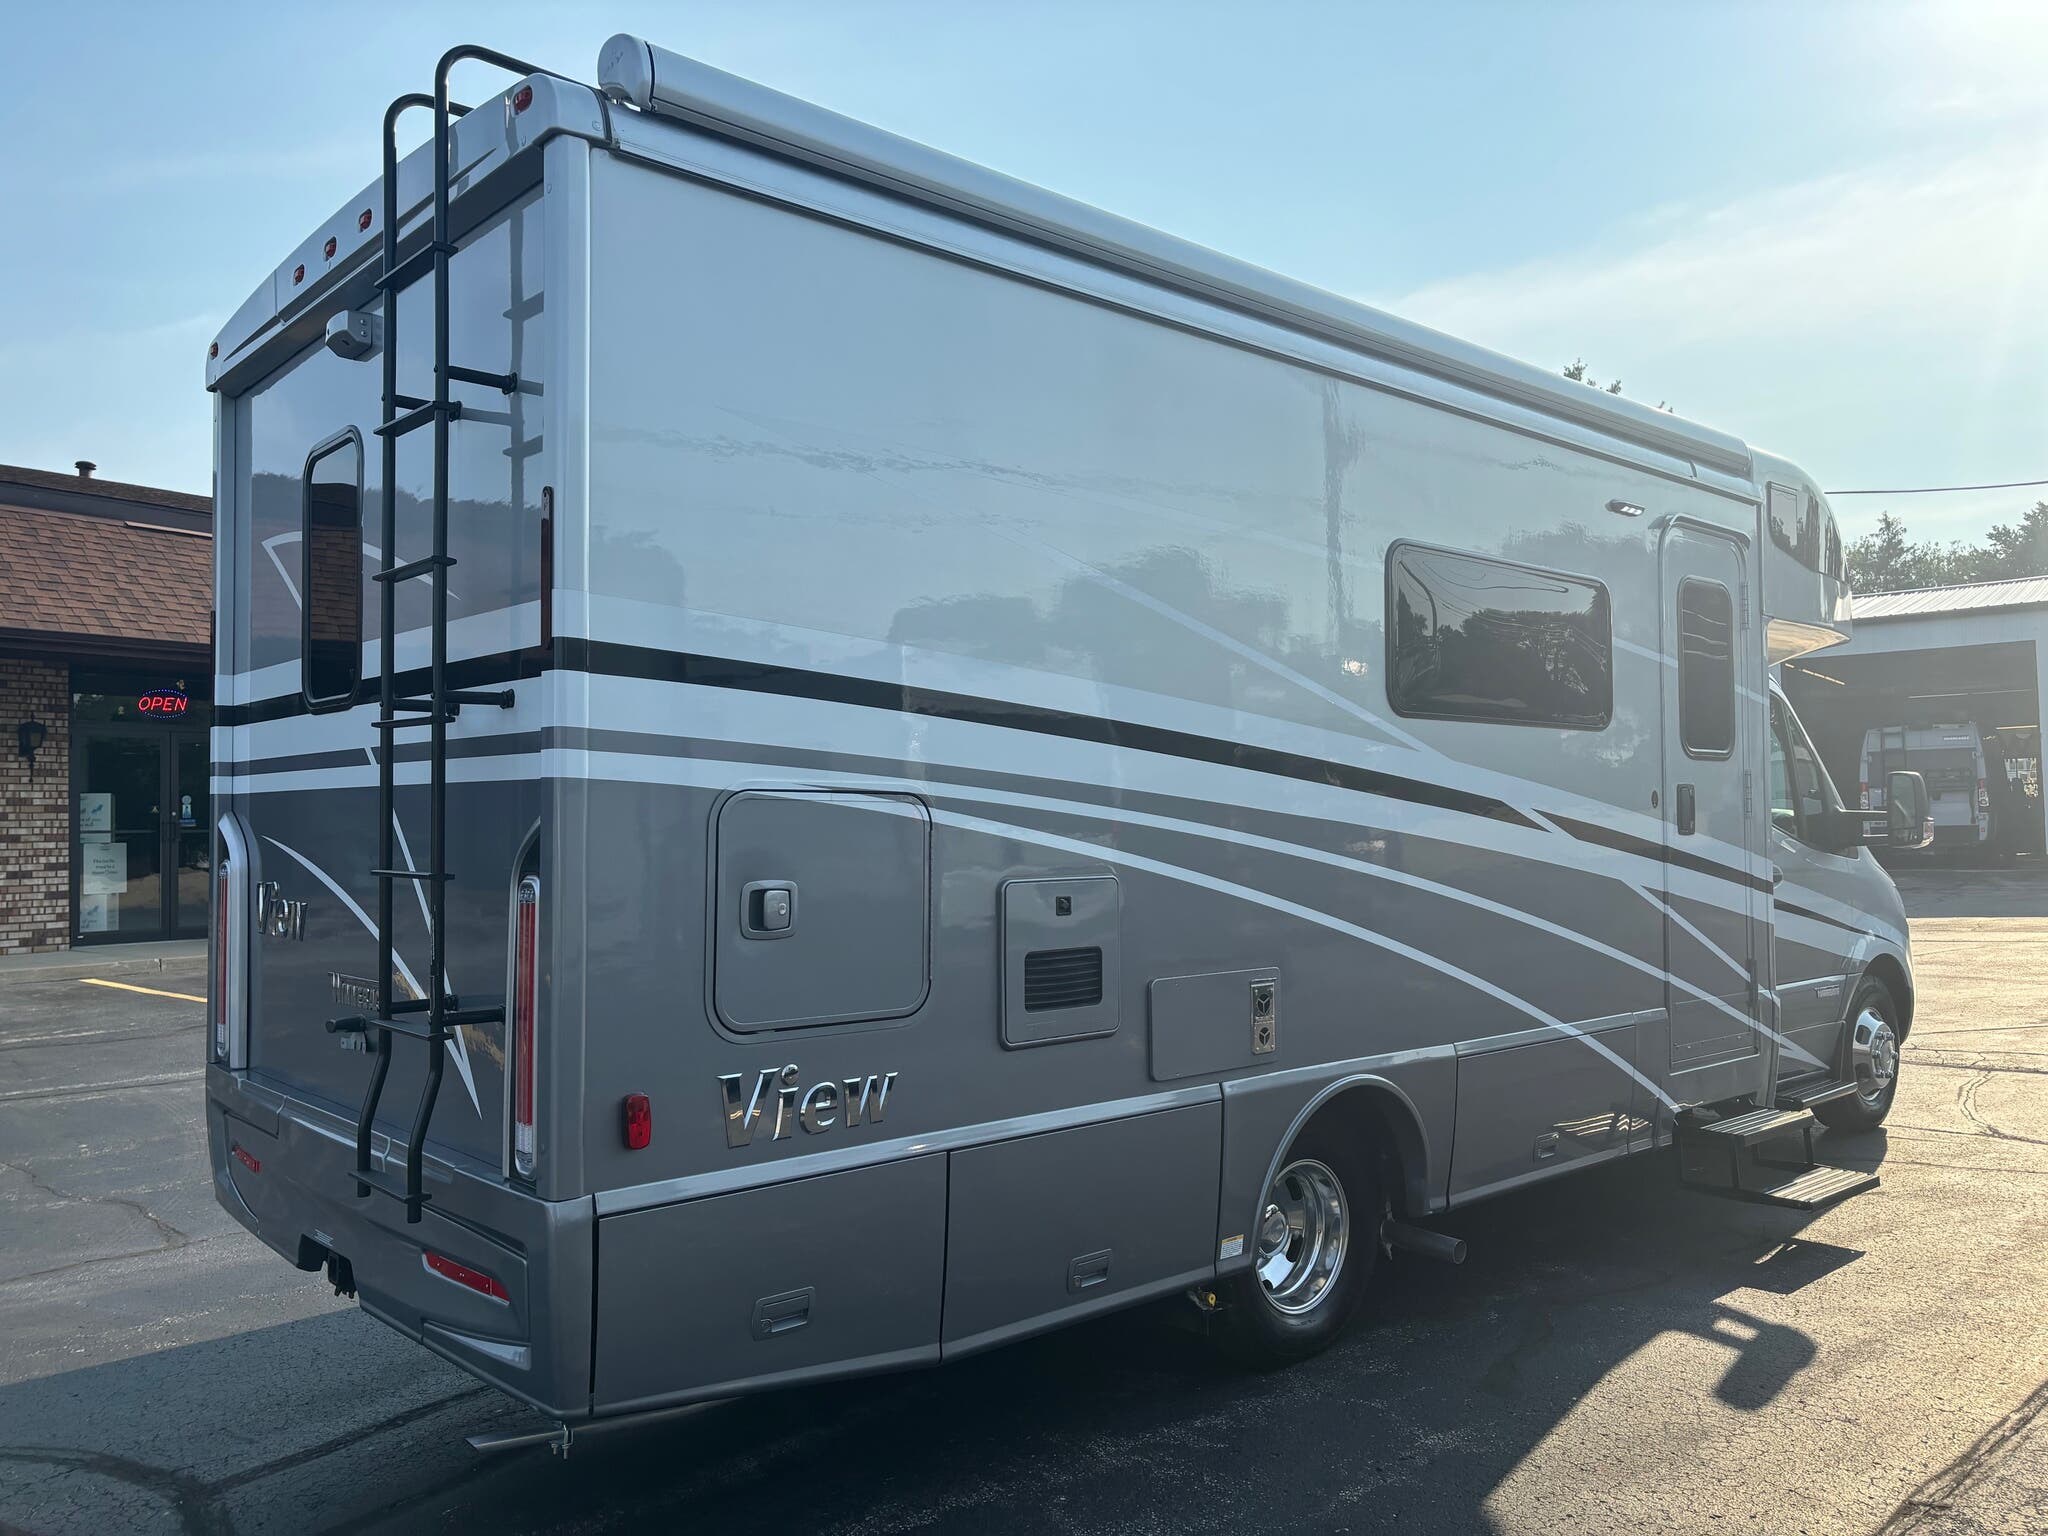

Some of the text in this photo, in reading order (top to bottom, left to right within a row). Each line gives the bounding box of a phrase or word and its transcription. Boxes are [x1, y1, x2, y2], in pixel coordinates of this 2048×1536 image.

[138, 696, 188, 711] OPEN
[256, 881, 308, 941] View
[716, 1063, 899, 1149] View
